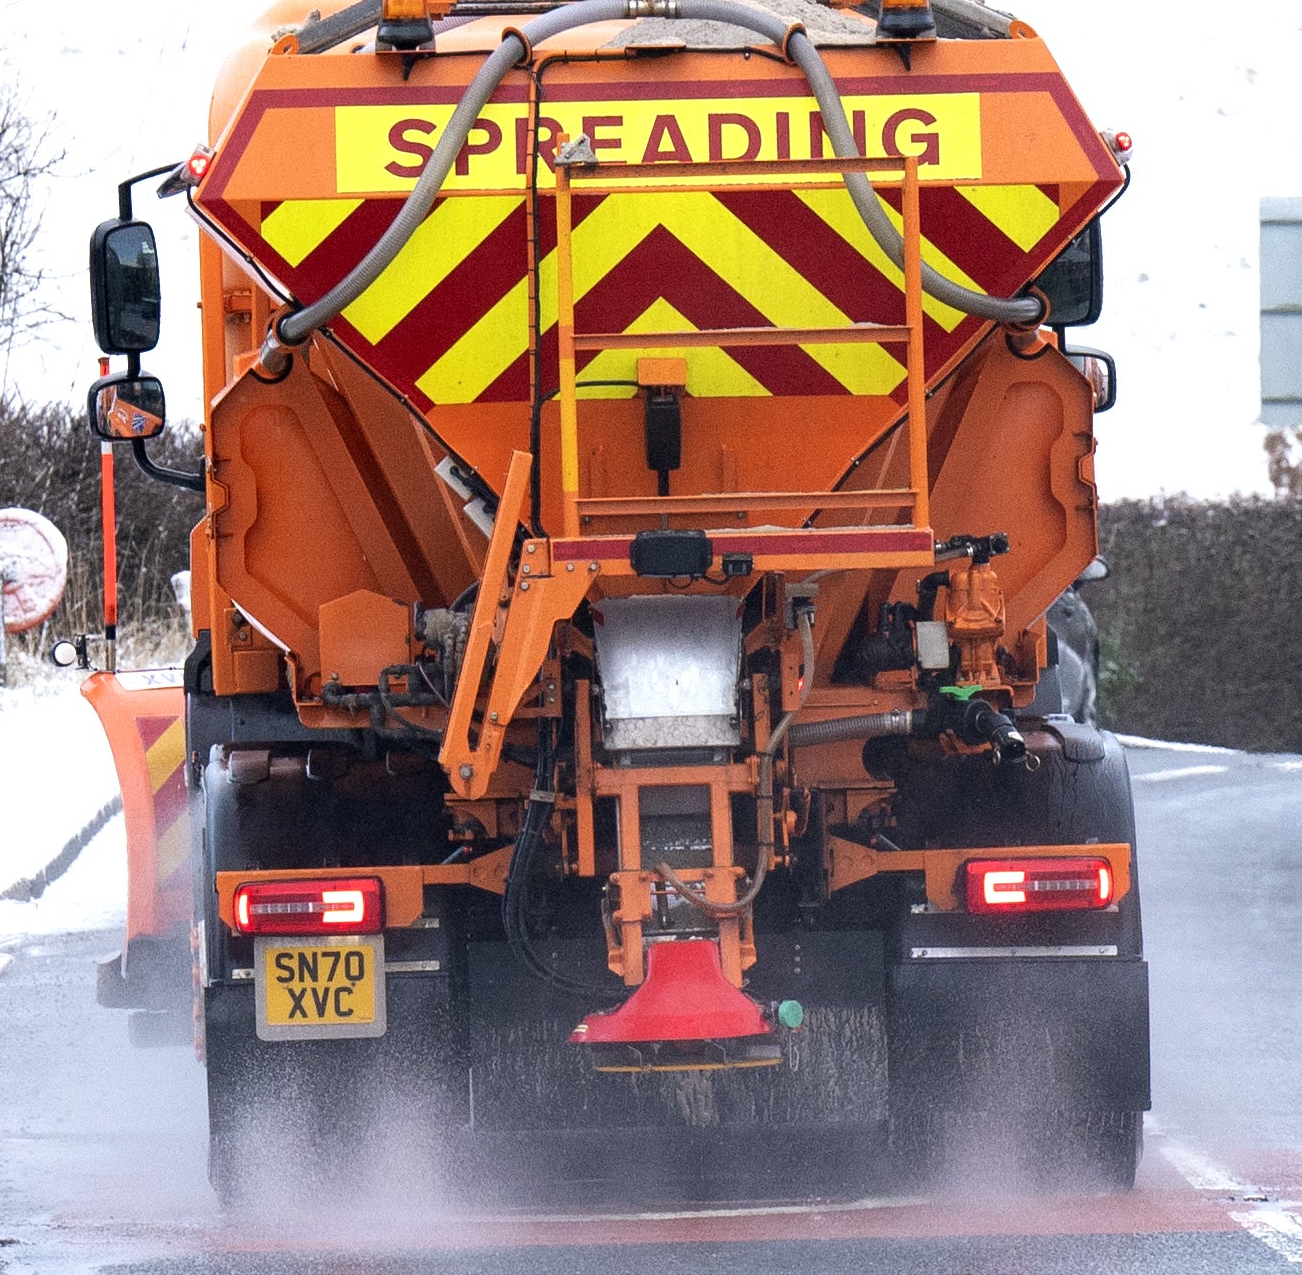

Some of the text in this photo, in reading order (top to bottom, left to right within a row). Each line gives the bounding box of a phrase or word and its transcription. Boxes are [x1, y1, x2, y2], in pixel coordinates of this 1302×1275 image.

[384, 107, 940, 179] SPREADING
[275, 951, 365, 983] SN70
[288, 987, 355, 1019] XVC
